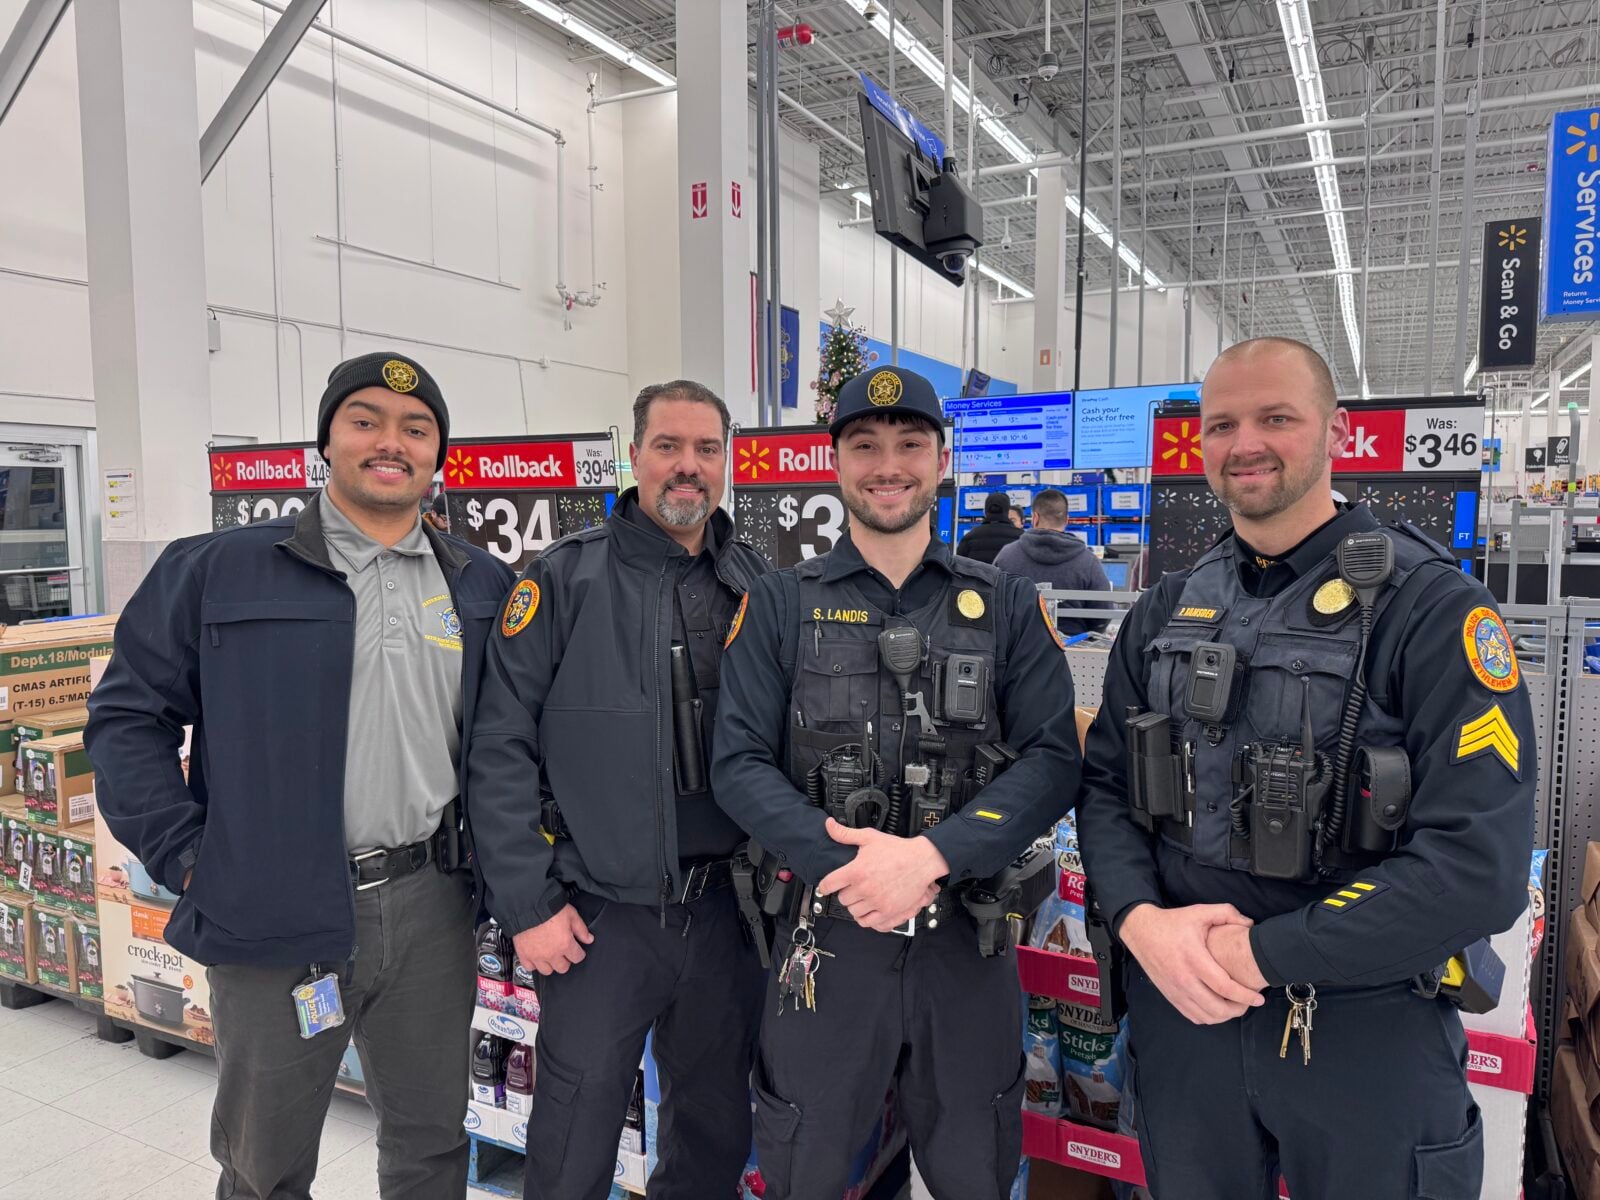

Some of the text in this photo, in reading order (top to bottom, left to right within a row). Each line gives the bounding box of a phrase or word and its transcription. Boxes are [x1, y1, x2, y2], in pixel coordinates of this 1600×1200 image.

[1573, 169, 1600, 284] Services
[1498, 257, 1520, 350] Scan & Go
[1563, 298, 1584, 306] Money
[946, 400, 1002, 410] Money Services
[1081, 407, 1100, 415] Cash
[1081, 413, 1135, 423] check for free
[1426, 417, 1457, 429] Was:
[586, 448, 602, 457] Was:
[236, 458, 302, 481] Rollback
[479, 454, 563, 479] Rollback
[466, 497, 560, 565] $34
[1458, 533, 1470, 541] FT
[813, 608, 869, 623] S. LANDIS
[1466, 613, 1481, 638] POLICE
[1471, 657, 1513, 688] BETHLEHEM
[12, 681, 46, 693] CMAS
[12, 698, 45, 712] (T-15)
[1070, 976, 1099, 990] SNYD
[307, 999, 319, 1024] POLICE
[1062, 1030, 1107, 1052] Sticks
